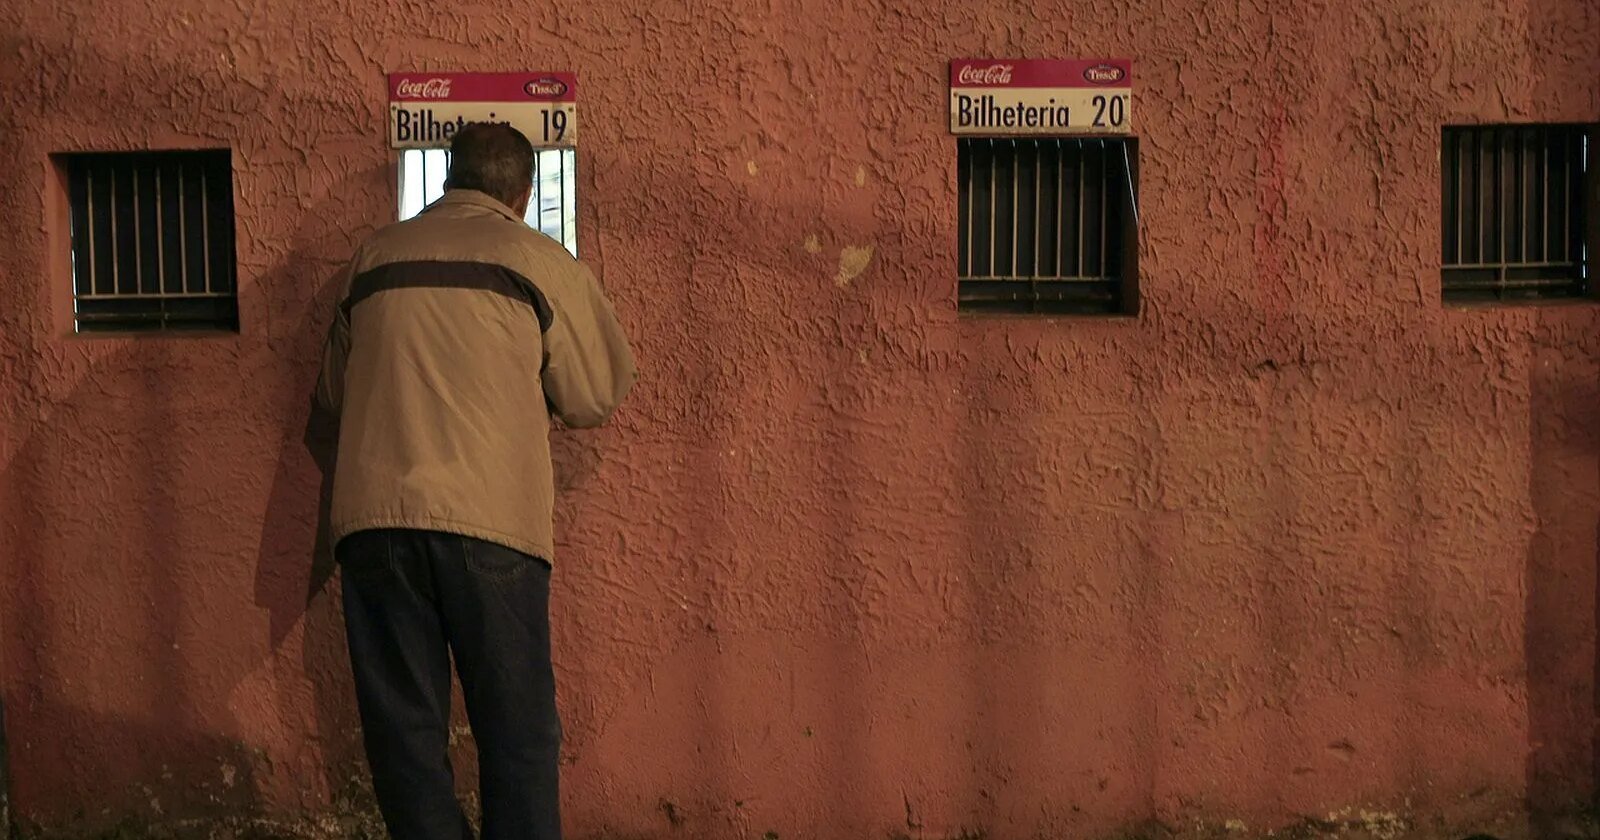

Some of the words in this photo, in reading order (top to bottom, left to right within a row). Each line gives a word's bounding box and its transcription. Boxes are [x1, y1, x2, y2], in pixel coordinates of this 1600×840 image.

[540, 110, 567, 142] 19
[958, 95, 1070, 127] Bilheteria
[1092, 95, 1124, 127] 20
